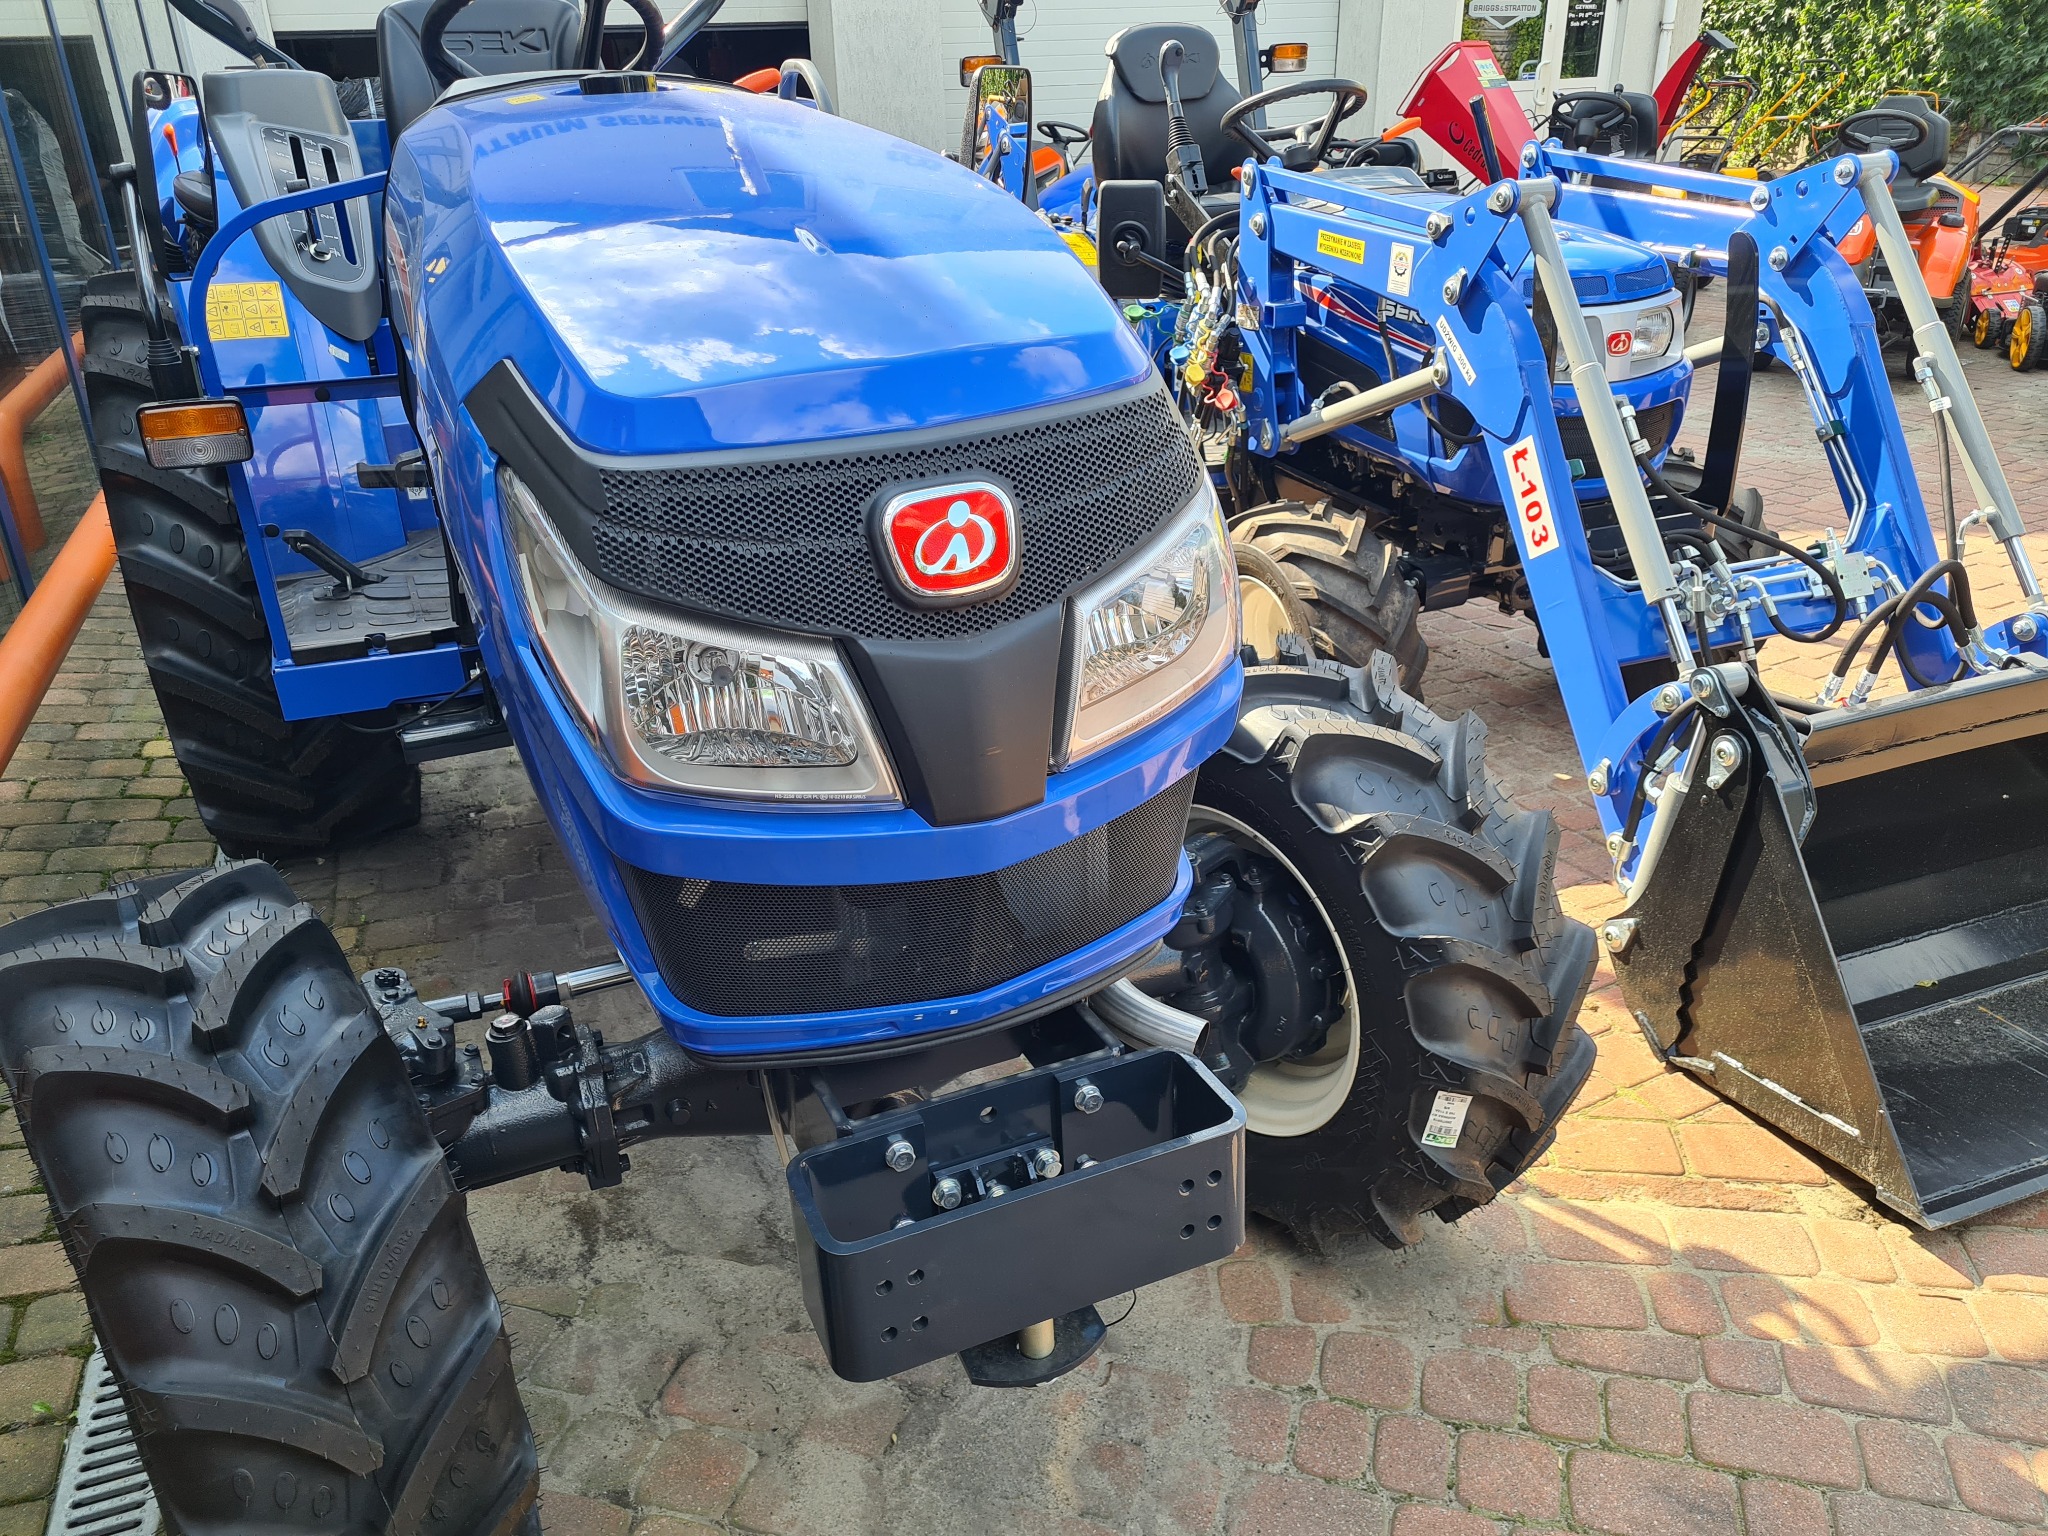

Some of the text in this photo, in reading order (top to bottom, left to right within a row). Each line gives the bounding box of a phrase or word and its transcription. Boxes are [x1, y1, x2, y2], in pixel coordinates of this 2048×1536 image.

[441, 28, 550, 56] SEKI
[1462, 139, 1488, 172] Cedru
[1384, 300, 1430, 326] SEK
[1465, 368, 1473, 382] kg
[1512, 447, 1549, 547] Ł-103
[1425, 1133, 1456, 1145] BKT
[189, 1225, 251, 1255] RADIAL
